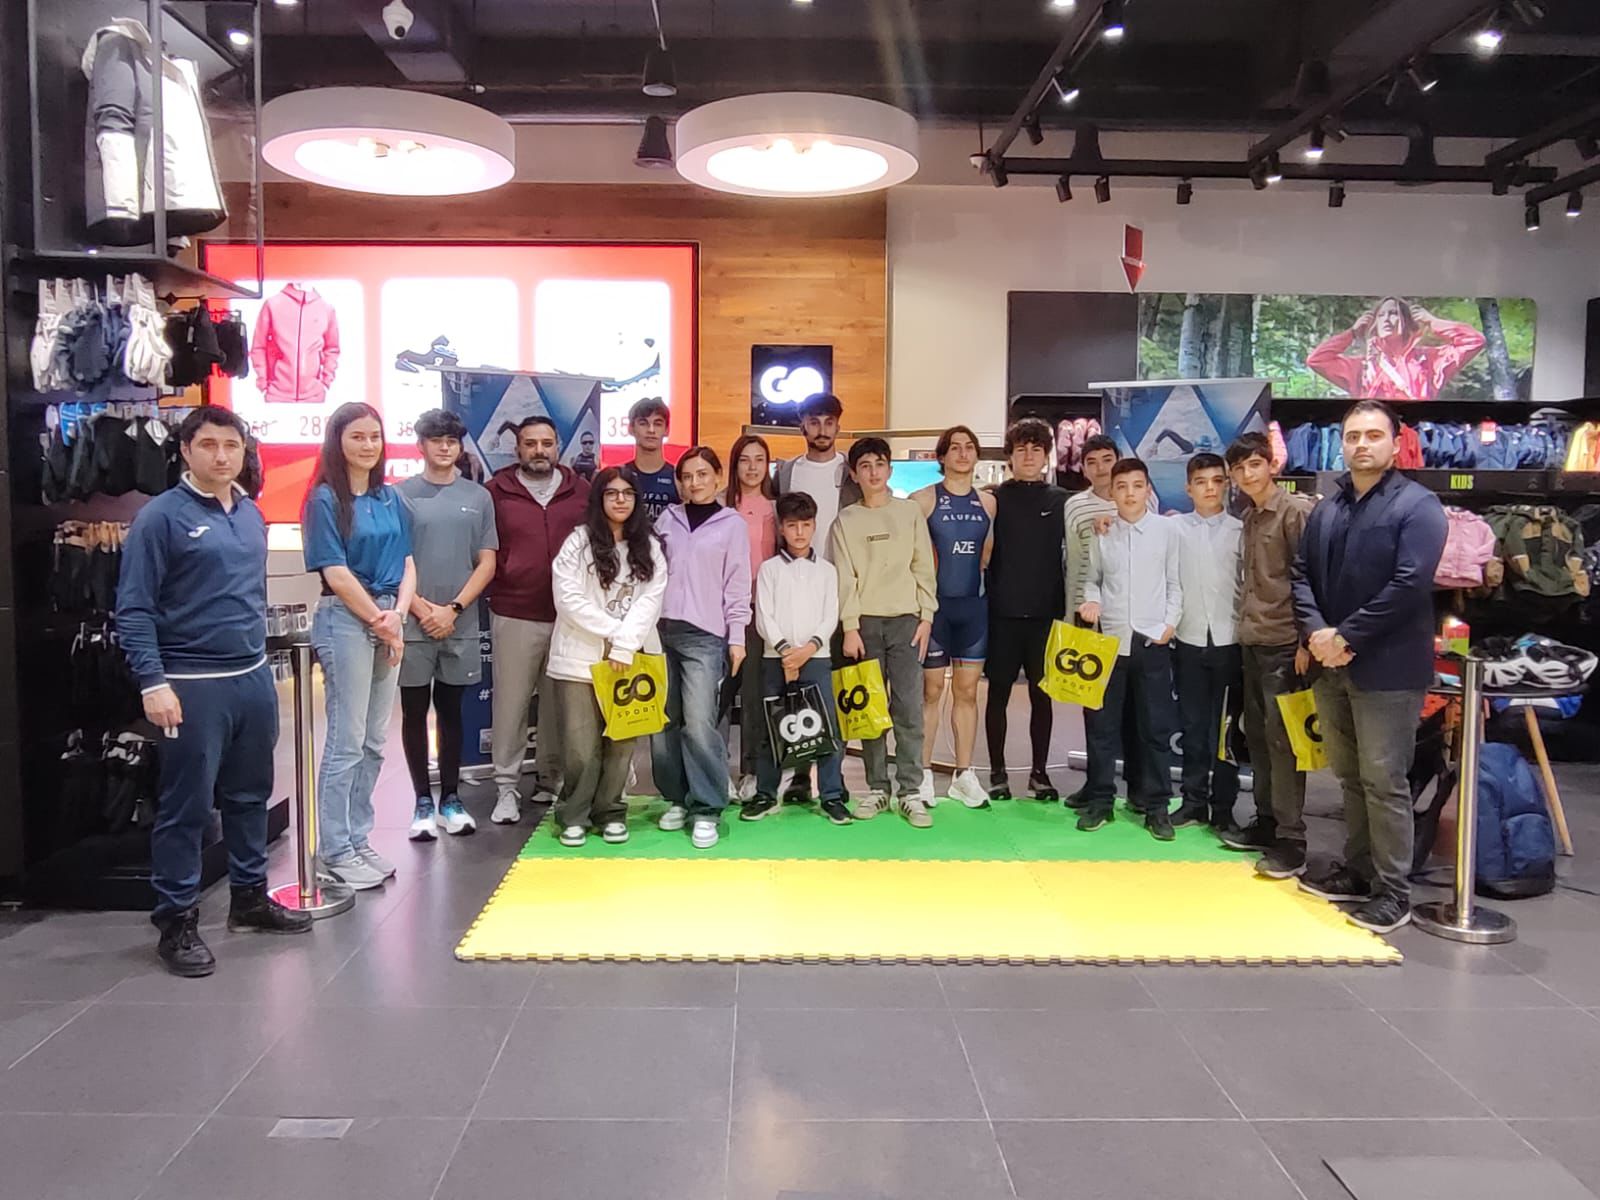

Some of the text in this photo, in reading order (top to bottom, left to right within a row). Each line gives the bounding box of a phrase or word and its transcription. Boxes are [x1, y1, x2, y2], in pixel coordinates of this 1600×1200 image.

[760, 366, 824, 404] GO
[1450, 474, 1474, 490] KIDS
[951, 540, 977, 555] AZE
[1055, 647, 1103, 682] GO
[613, 672, 657, 707] GO
[838, 684, 870, 715] GO
[779, 708, 823, 743] GO
[786, 737, 823, 754] SPORT
